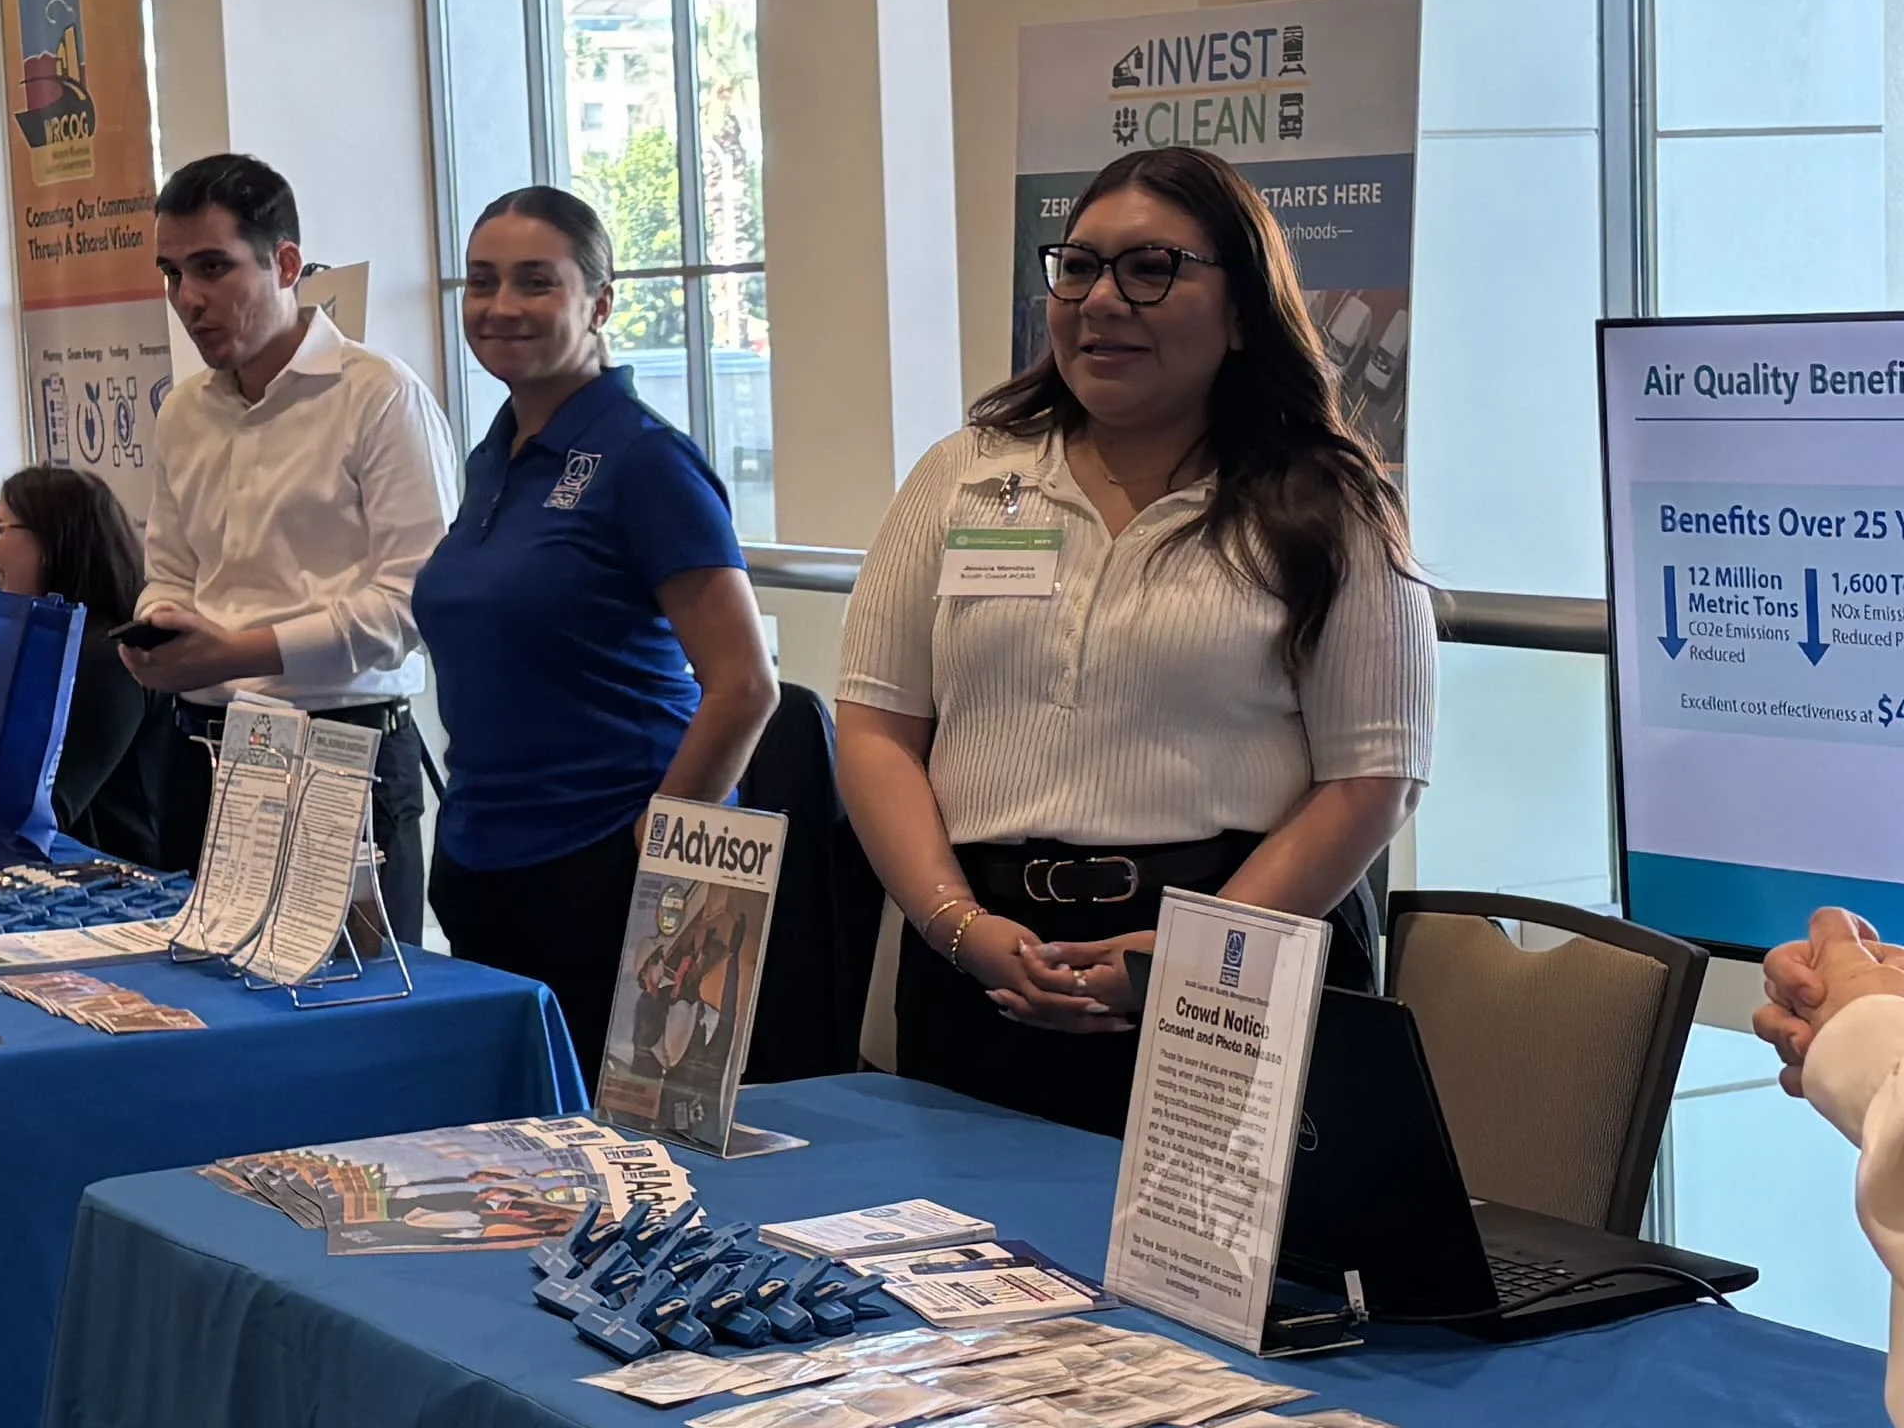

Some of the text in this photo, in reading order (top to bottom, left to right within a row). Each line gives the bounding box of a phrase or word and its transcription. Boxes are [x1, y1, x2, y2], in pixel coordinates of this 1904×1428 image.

[1147, 28, 1278, 87] INVEST
[1145, 94, 1267, 148] CLEAN
[1262, 184, 1327, 207] STARTS
[1335, 183, 1381, 205] HERE
[66, 233, 73, 255] A
[109, 225, 143, 250] Vision
[1644, 364, 1685, 396] Air
[1695, 362, 1799, 405] Quality
[1660, 505, 1770, 537] Benefits
[1779, 507, 1846, 539] Over
[1854, 510, 1887, 539] 25
[1688, 567, 1782, 590] 12 Million
[1832, 572, 1888, 595] 1,600
[1689, 593, 1798, 618] Metric Tons
[1726, 623, 1790, 642] Emissions
[1833, 629, 1892, 648] Reduced
[1690, 646, 1745, 664] Reduced
[1681, 694, 1737, 714] Excellent
[1741, 700, 1767, 715] cost
[1769, 700, 1856, 723] effectiveness
[1860, 709, 1873, 723] at
[664, 817, 773, 876] Advisor
[1176, 996, 1269, 1039] Crowd Notice
[1158, 1018, 1194, 1039] Consent
[1196, 1031, 1218, 1046] and
[1216, 1035, 1242, 1053] Photo
